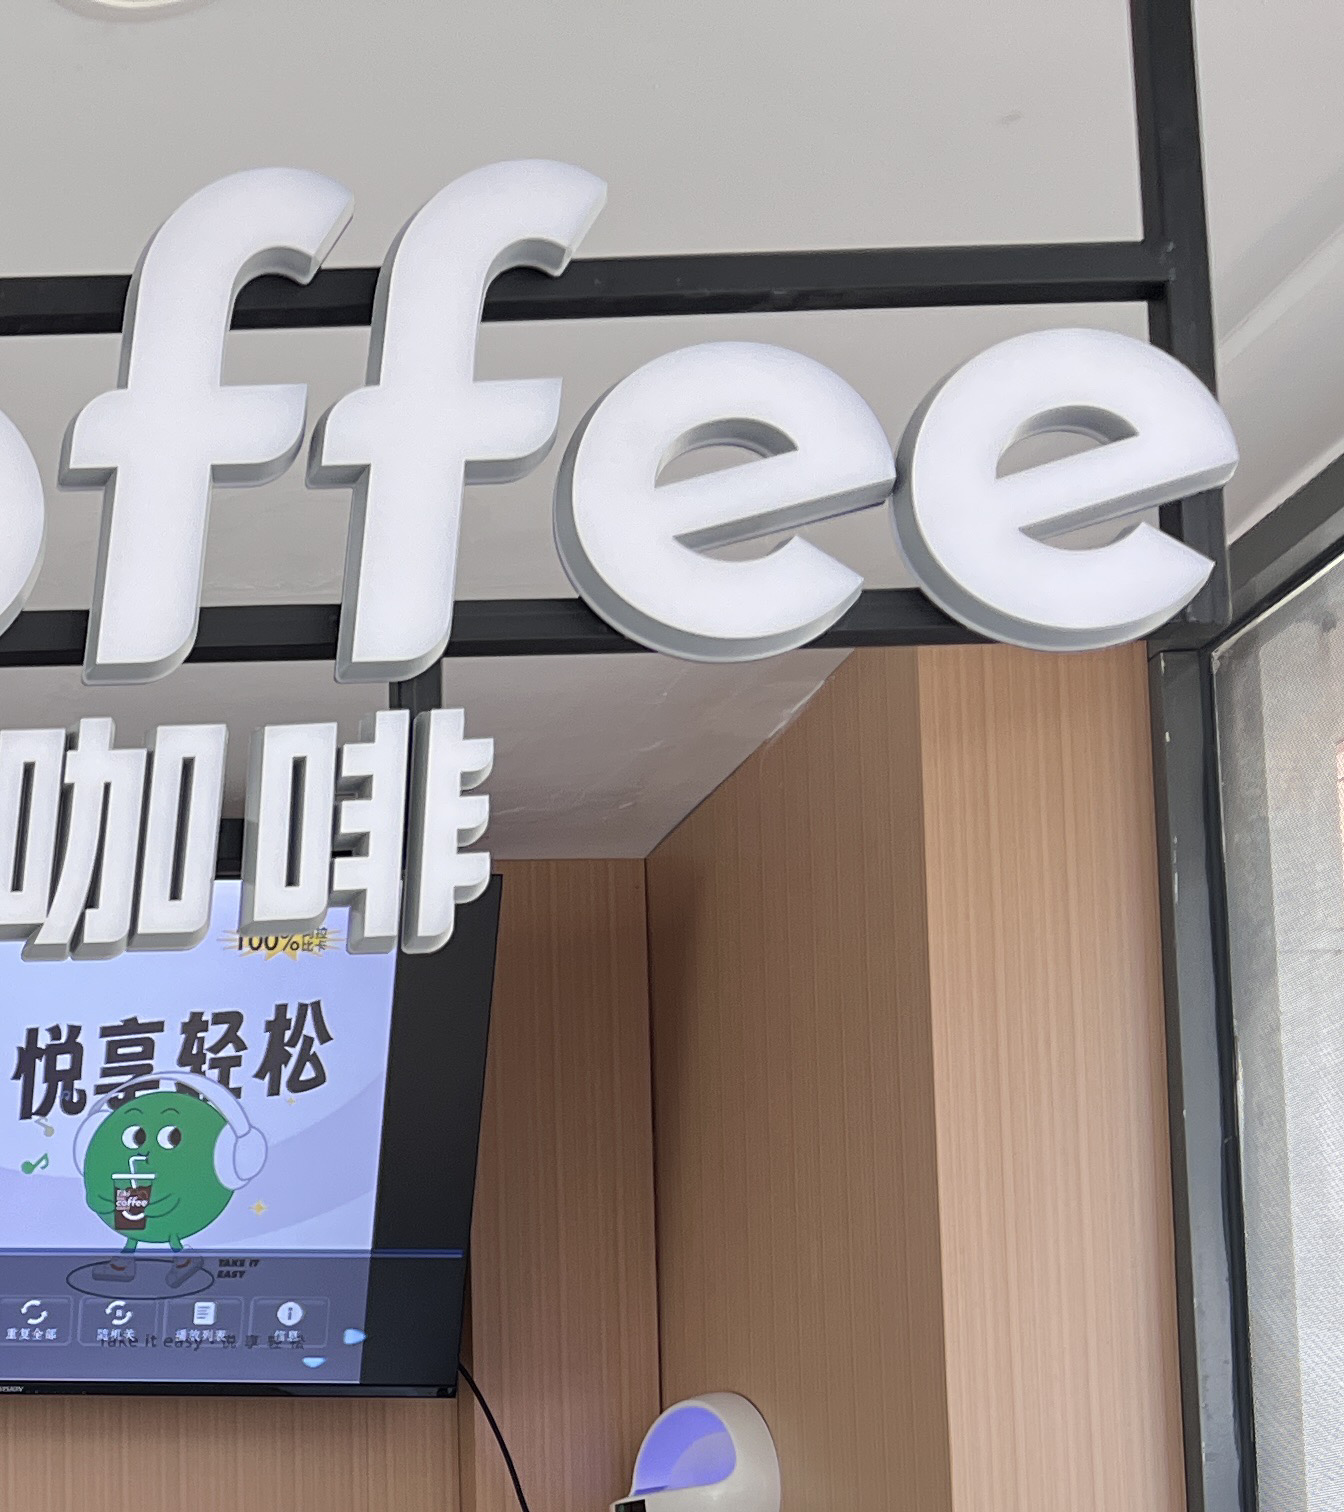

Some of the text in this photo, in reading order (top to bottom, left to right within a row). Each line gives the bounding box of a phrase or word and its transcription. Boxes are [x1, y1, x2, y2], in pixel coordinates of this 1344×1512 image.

[11, 1000, 334, 1121] 悦享轻松
[6, 1327, 57, 1341] 重复全部
